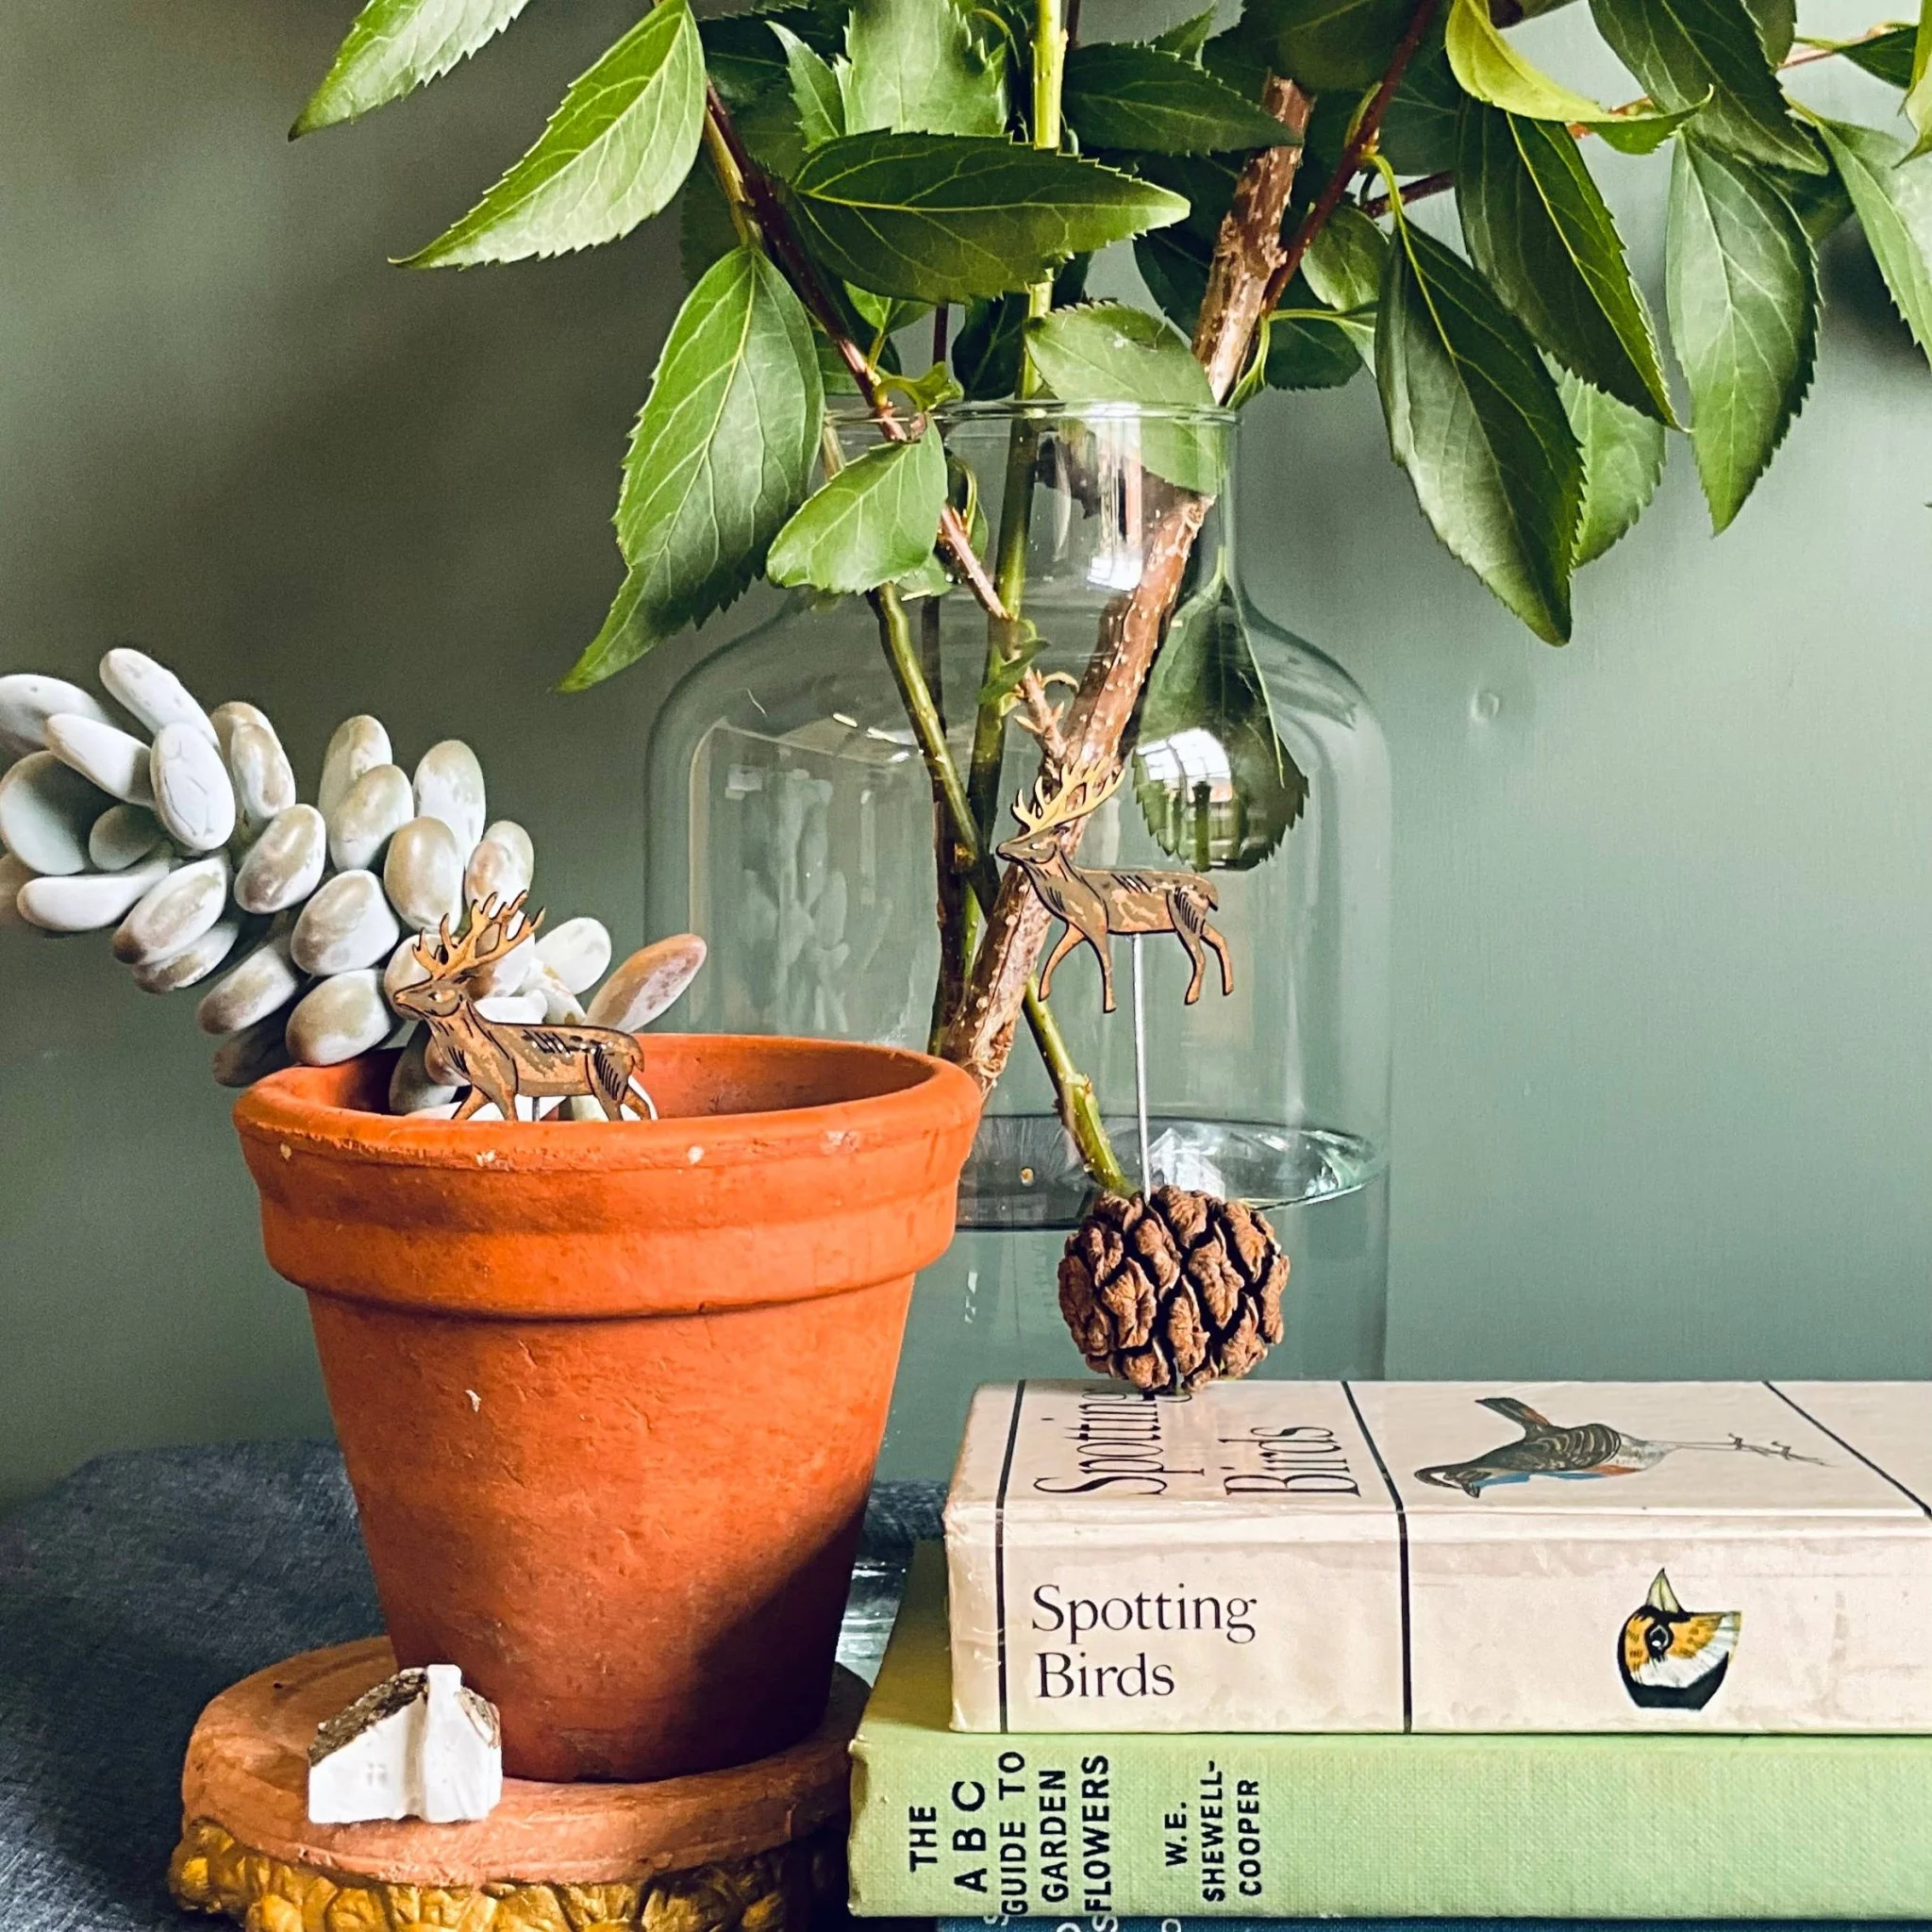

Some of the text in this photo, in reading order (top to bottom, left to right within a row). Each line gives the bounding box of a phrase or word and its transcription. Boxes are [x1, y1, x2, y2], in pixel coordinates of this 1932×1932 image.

[1033, 1389, 1205, 1495] Spotting
[1218, 1425, 1361, 1497] Birds
[1032, 1583, 1257, 1645] Spotting
[1037, 1652, 1175, 1698] Birds
[908, 1806, 939, 1874] THE
[998, 1751, 1029, 1916] GUIDE TO
[1038, 1770, 1070, 1903] GARDEN
[1080, 1755, 1112, 1912] FLOWERS
[1200, 1760, 1226, 1903] SHEWELL-
[1237, 1779, 1262, 1897] COOPER
